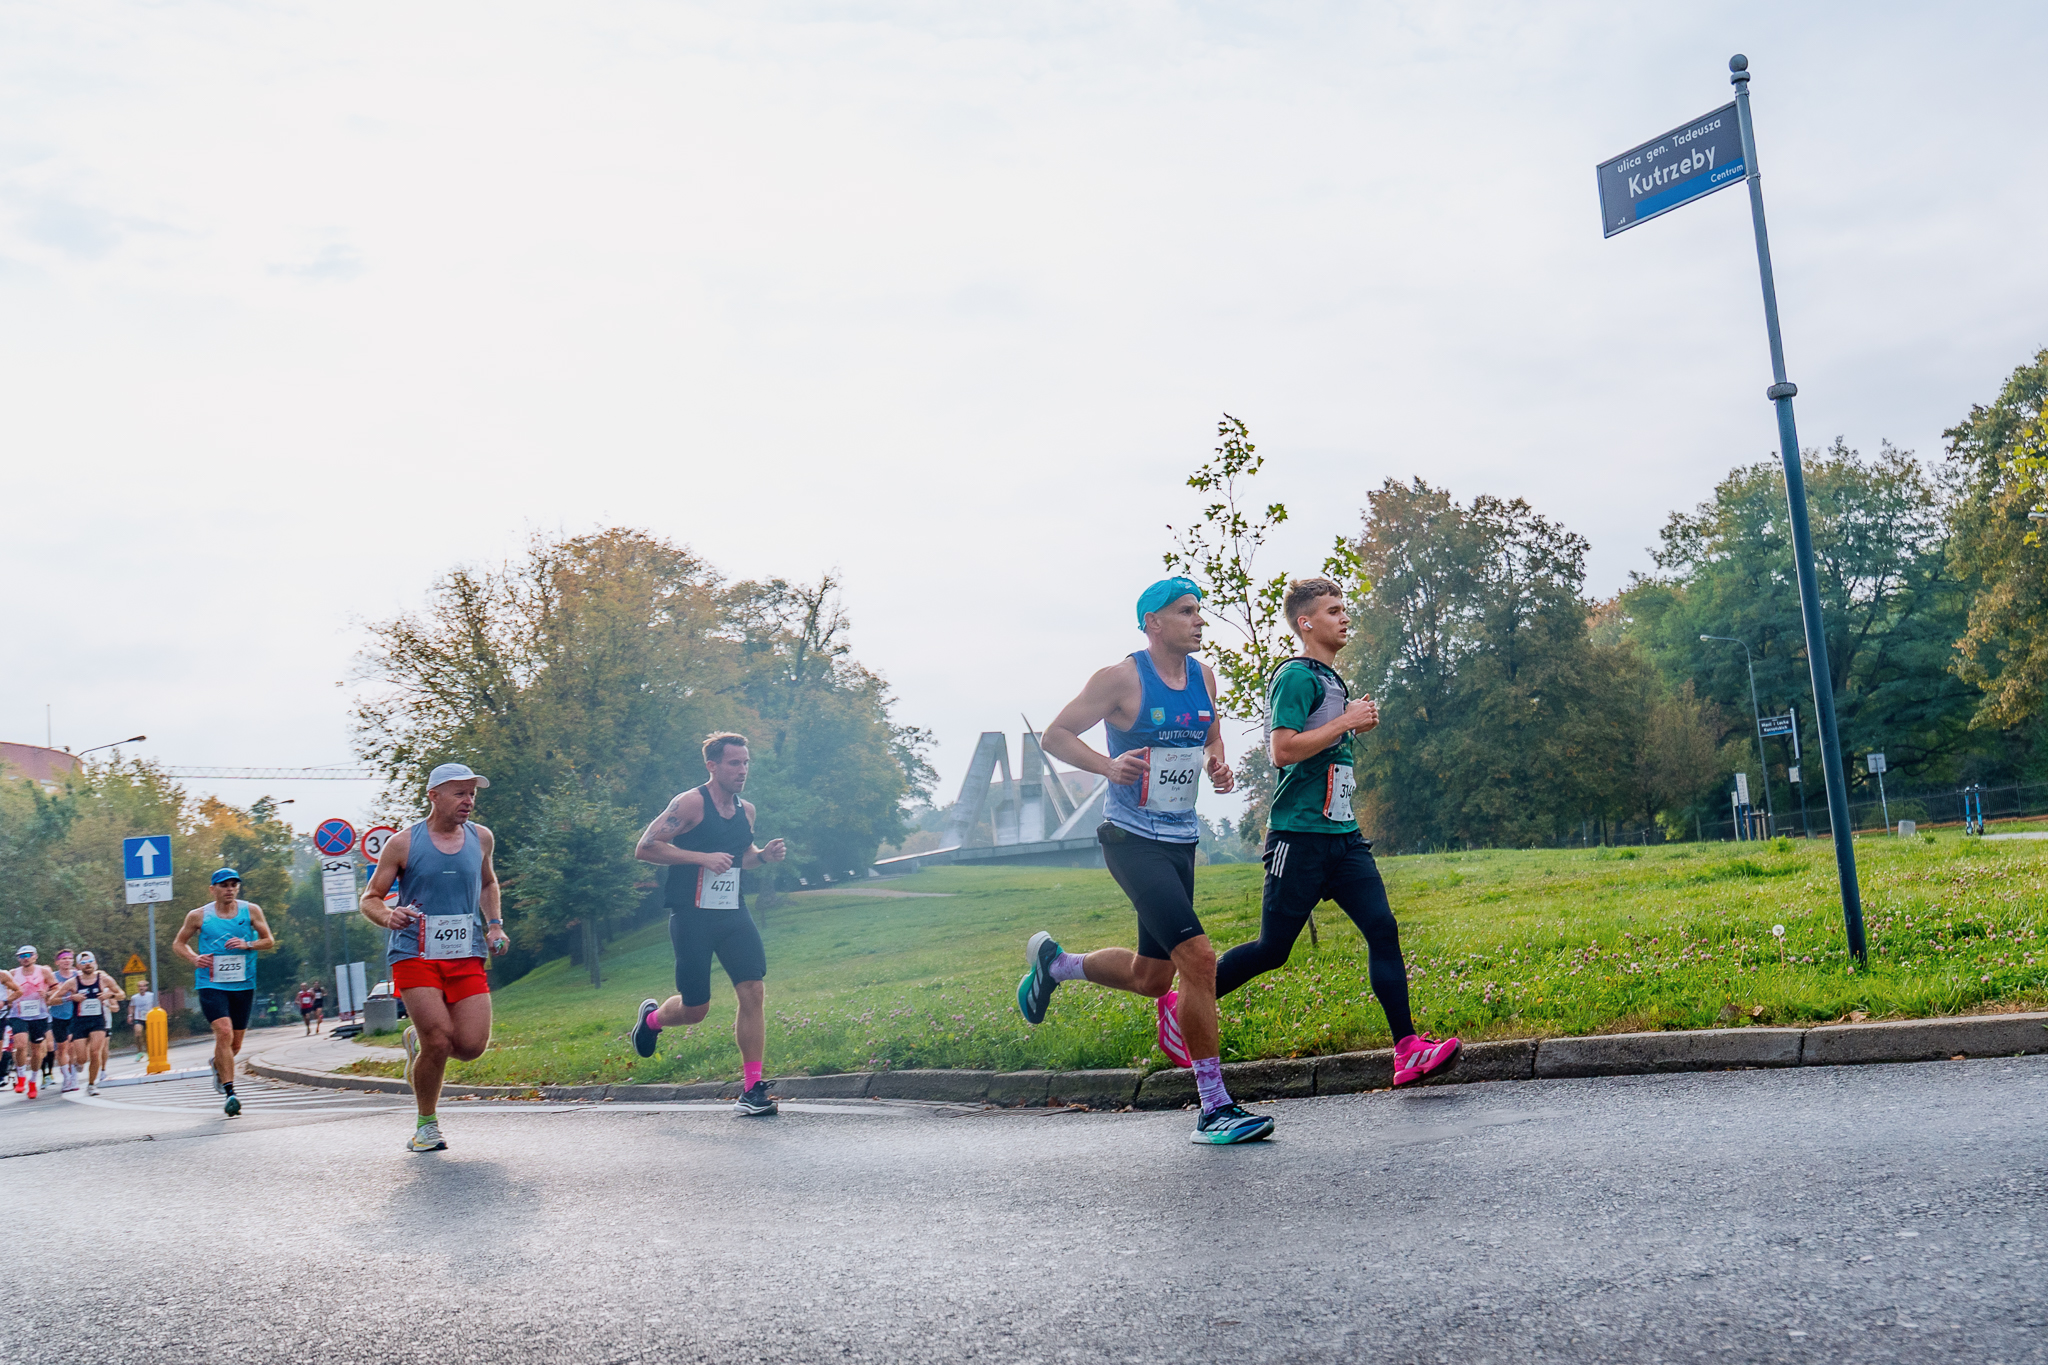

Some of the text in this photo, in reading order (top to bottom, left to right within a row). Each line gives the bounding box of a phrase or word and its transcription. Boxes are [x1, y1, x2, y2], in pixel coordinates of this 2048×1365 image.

[1617, 118, 1721, 173] ulica gen. Tadeusza
[1628, 146, 1716, 198] Kutrzeby
[1710, 163, 1744, 183] Centrum
[1159, 769, 1194, 785] 5462
[368, 836, 390, 854] 3
[711, 880, 734, 891] 4721
[434, 928, 466, 940] 4918
[219, 963, 241, 971] 2235
